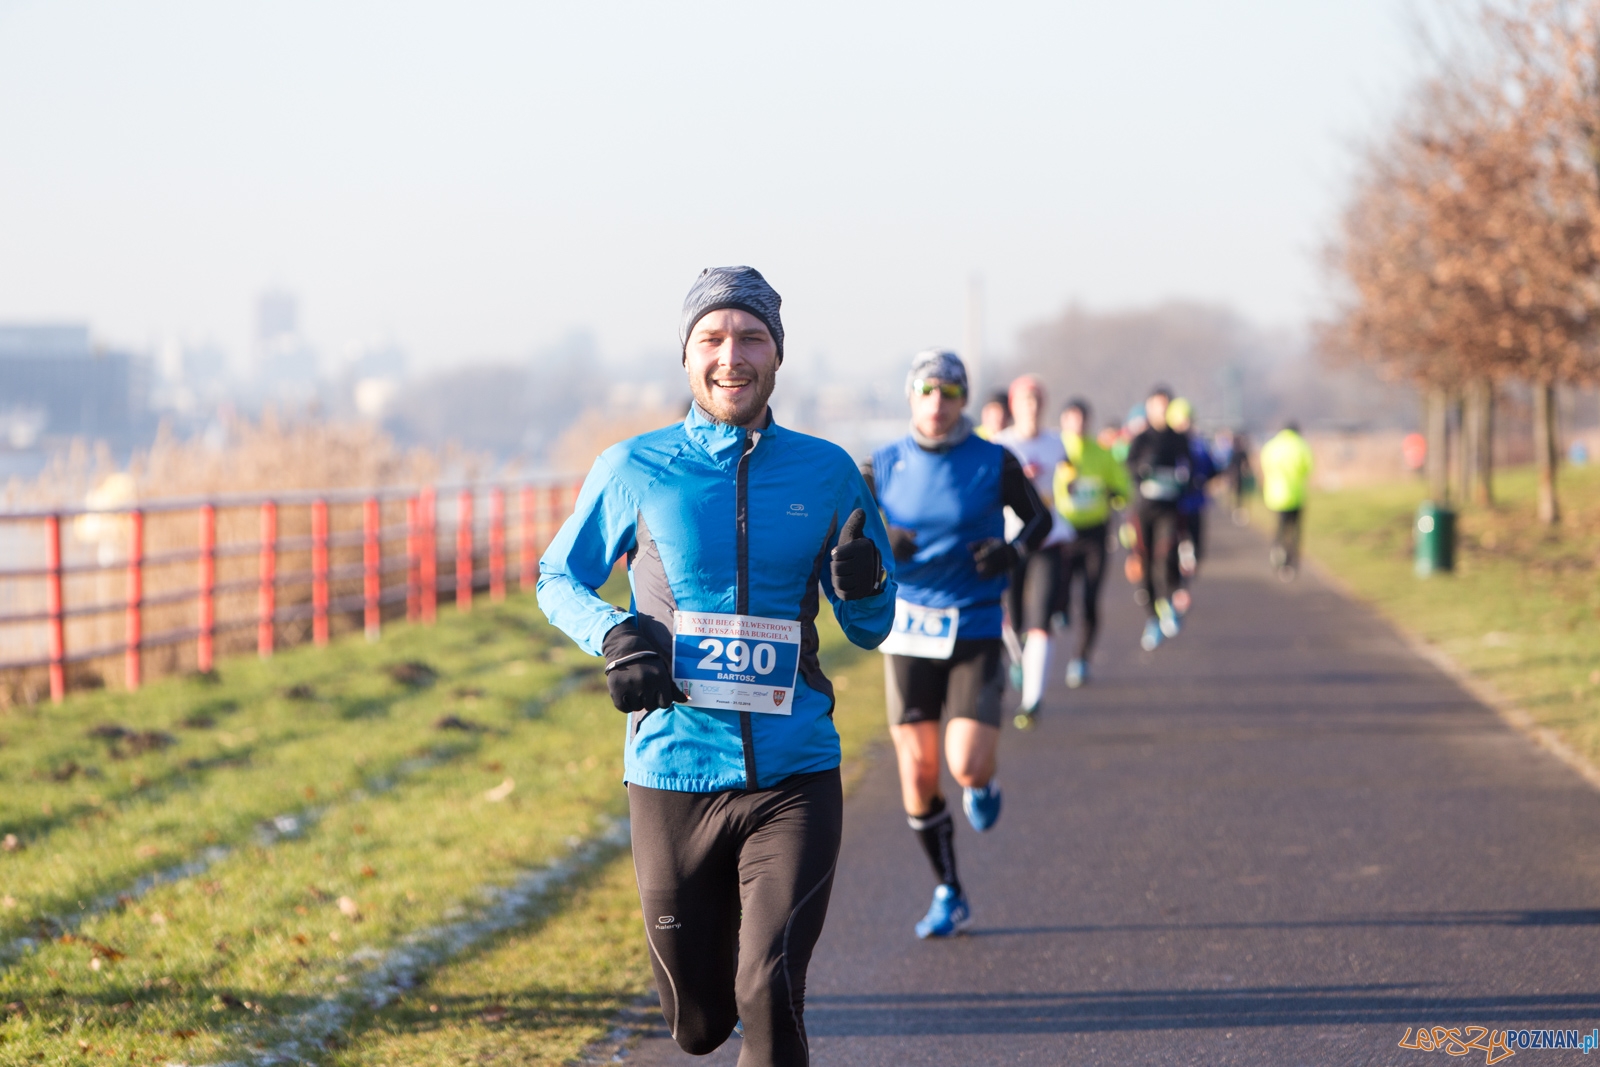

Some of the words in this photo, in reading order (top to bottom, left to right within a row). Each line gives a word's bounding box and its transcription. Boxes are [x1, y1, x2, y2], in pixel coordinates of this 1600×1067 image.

[692, 617, 714, 625] XXXII
[715, 618, 735, 627] BIEG
[736, 621, 793, 632] SYLWESTROWY
[708, 628, 750, 636] RYSZARDA
[751, 631, 789, 640] BURGIELA
[697, 639, 776, 675] 290
[717, 673, 756, 682] BARTOSZ
